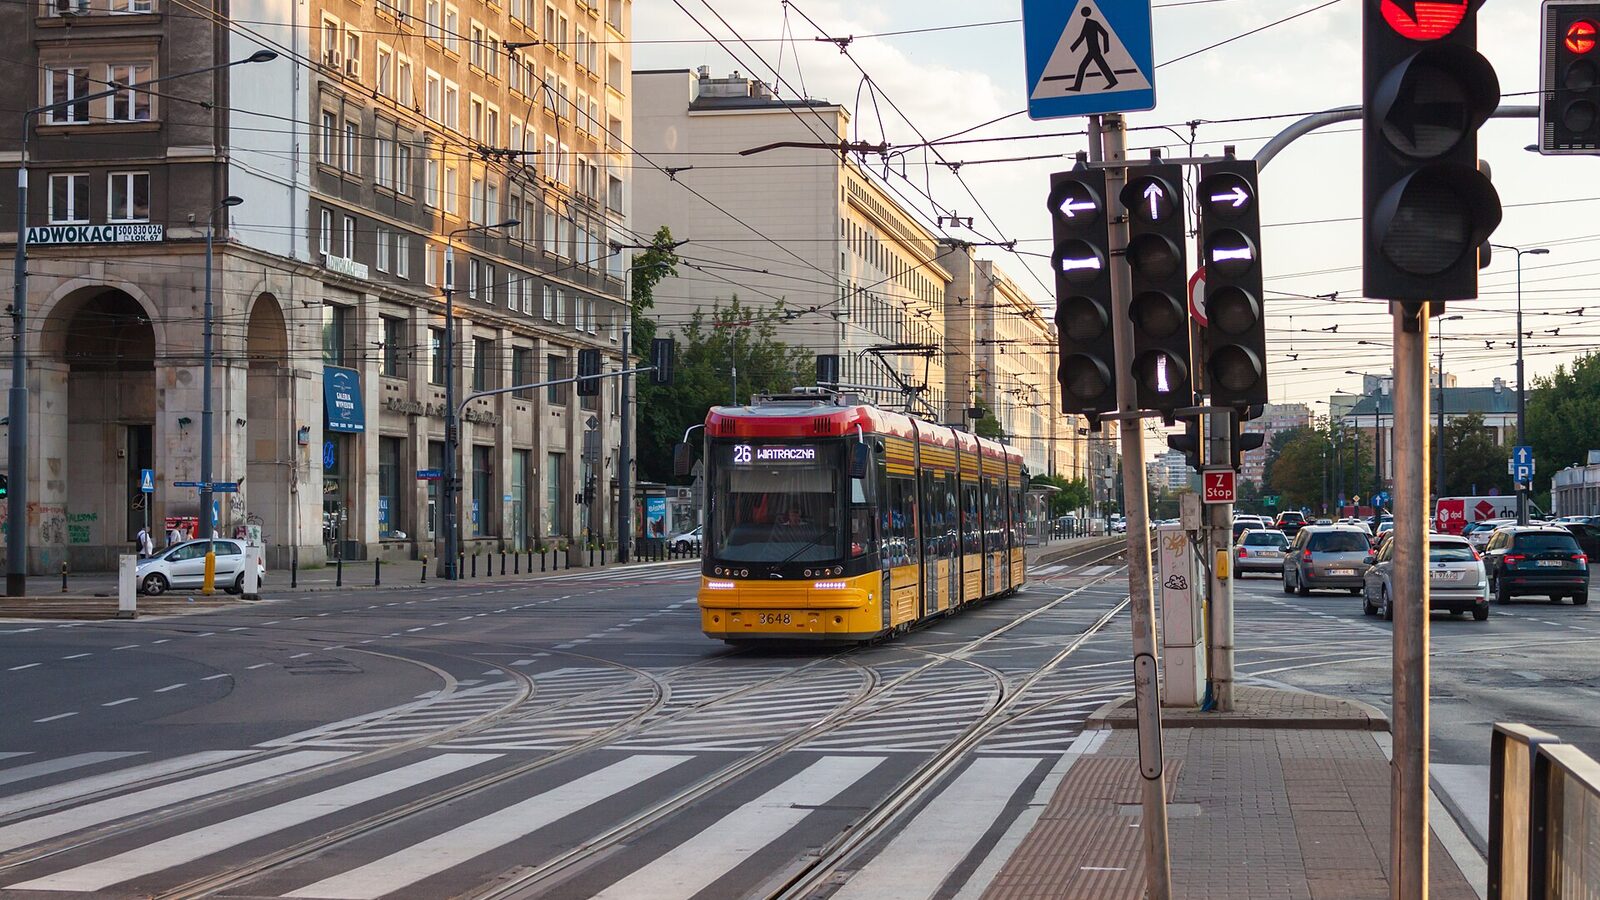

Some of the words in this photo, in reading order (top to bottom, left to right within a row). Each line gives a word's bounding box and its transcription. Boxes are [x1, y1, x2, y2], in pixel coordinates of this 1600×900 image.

[27, 226, 117, 242] ADWOKACI
[734, 445, 751, 462] 26
[757, 449, 815, 459] WIATRACZNA
[1216, 474, 1224, 487] Z
[1207, 487, 1232, 499] Stop
[1450, 511, 1462, 519] dpd
[1500, 506, 1518, 518] dp
[759, 612, 791, 625] 3648
